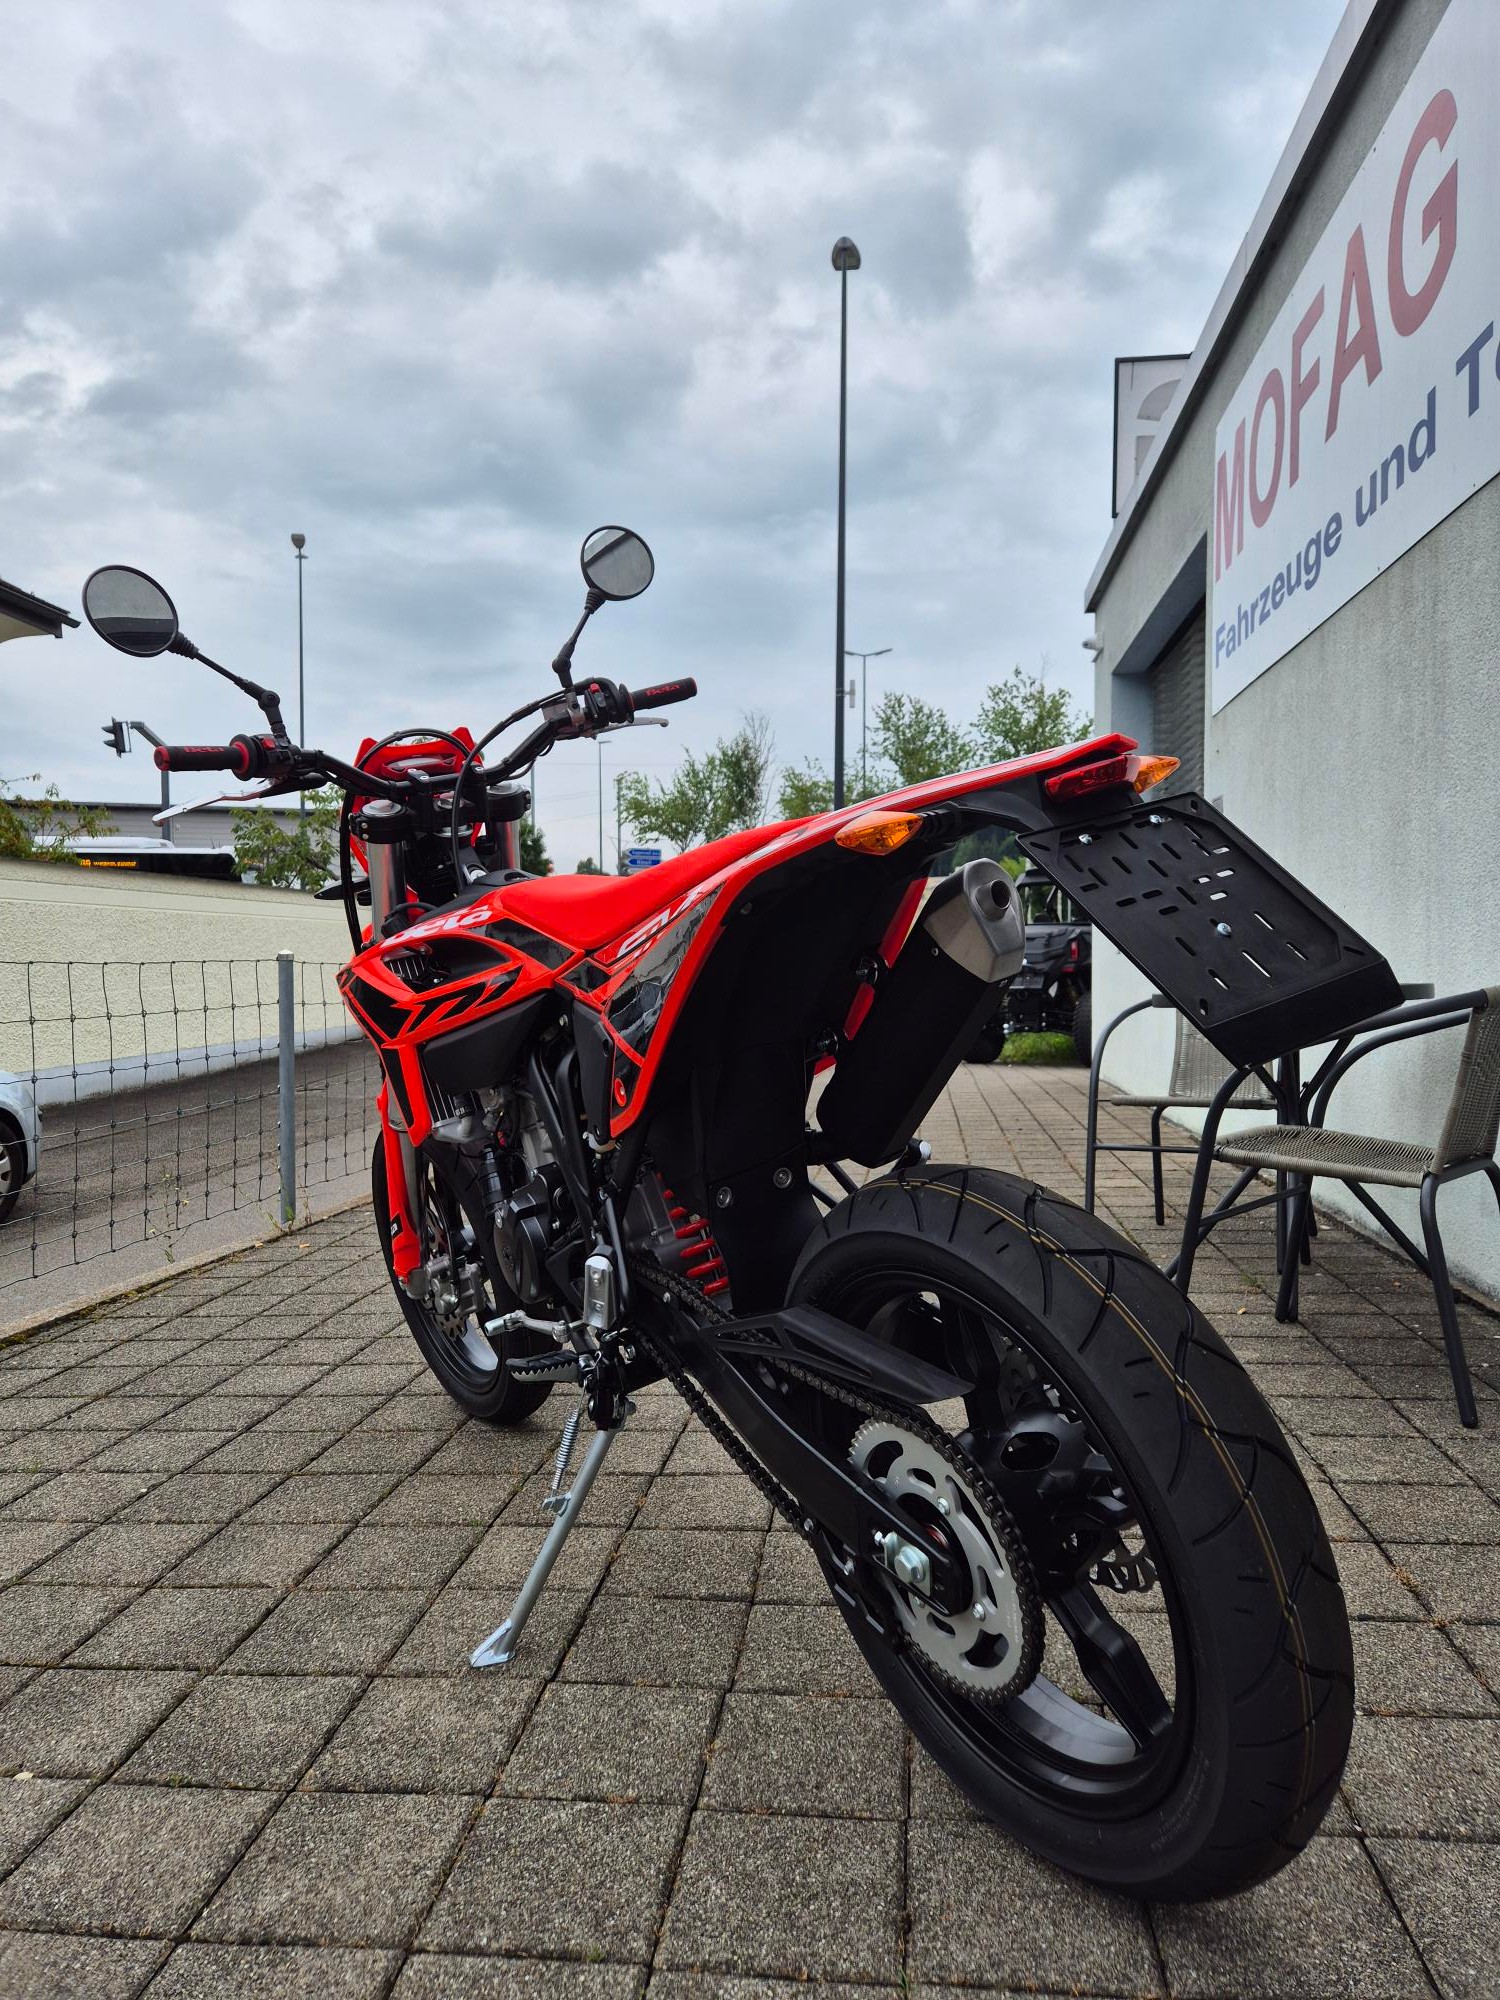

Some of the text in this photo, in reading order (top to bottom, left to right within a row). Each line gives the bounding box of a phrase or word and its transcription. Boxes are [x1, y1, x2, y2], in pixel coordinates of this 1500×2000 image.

[1215, 89, 1458, 583] MOFAG
[1215, 320, 1500, 669] Fahrzeuge und T
